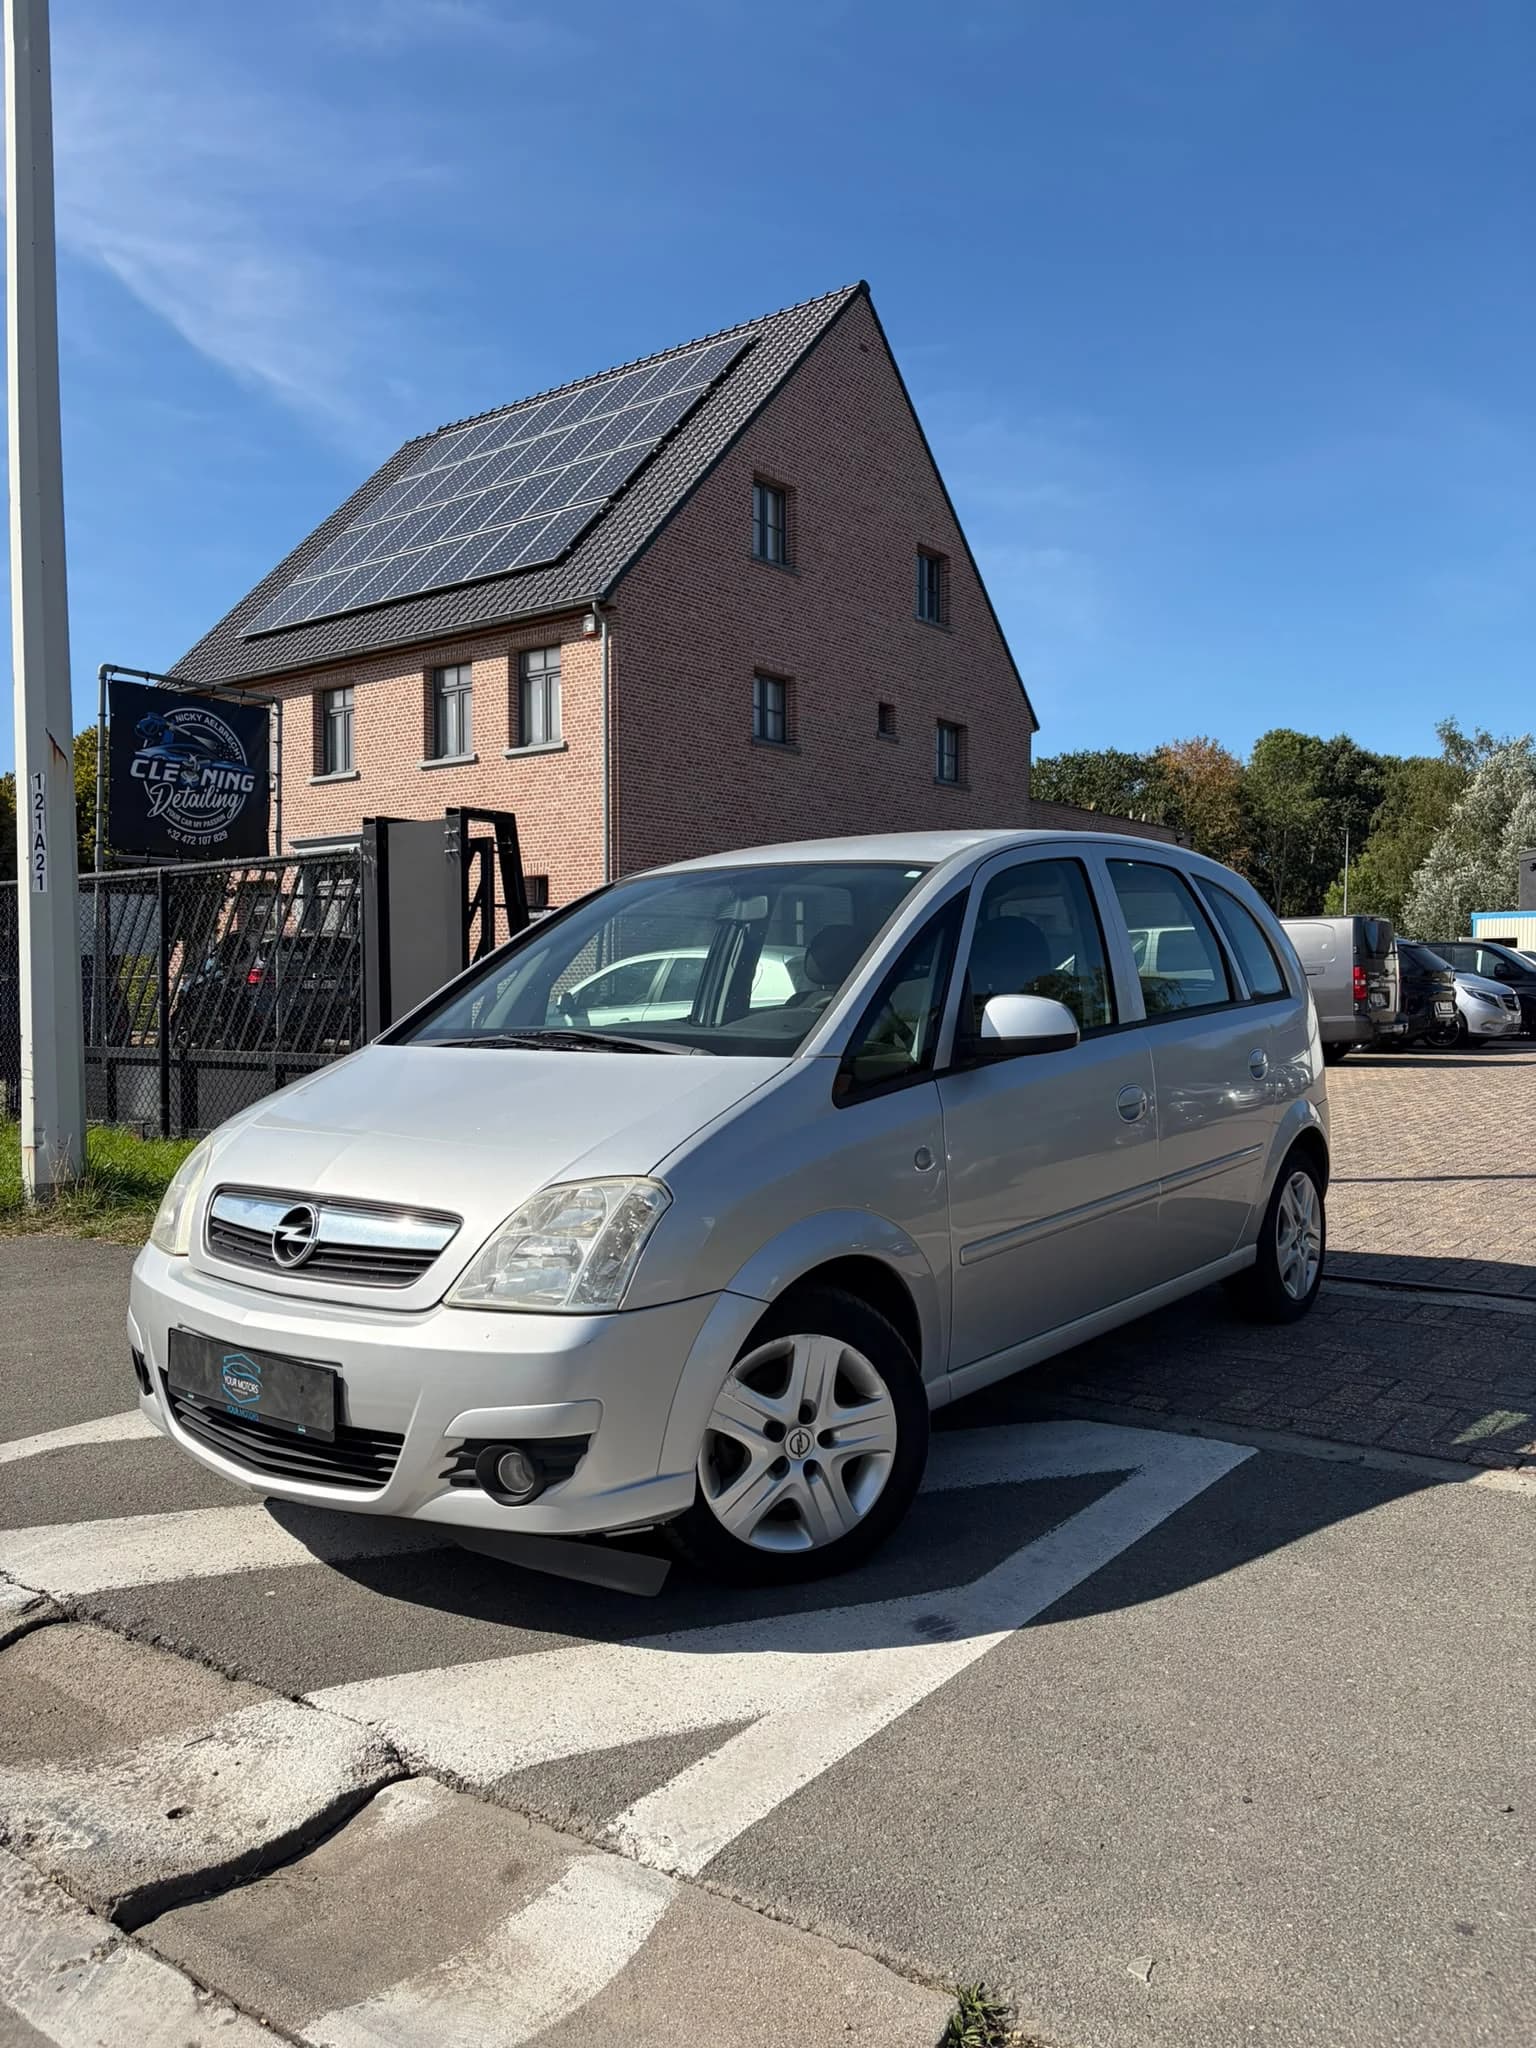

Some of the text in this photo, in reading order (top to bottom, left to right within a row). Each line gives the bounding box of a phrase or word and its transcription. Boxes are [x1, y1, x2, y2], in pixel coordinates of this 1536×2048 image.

[175, 712, 243, 761] NICKY AELBRECHT
[130, 758, 255, 792] CLENING
[147, 782, 242, 818] Detailing
[33, 772, 46, 891] 121A21
[167, 828, 228, 846] +32 472 107 829
[180, 817, 193, 827] CAR
[237, 1379, 259, 1394] MOTORS
